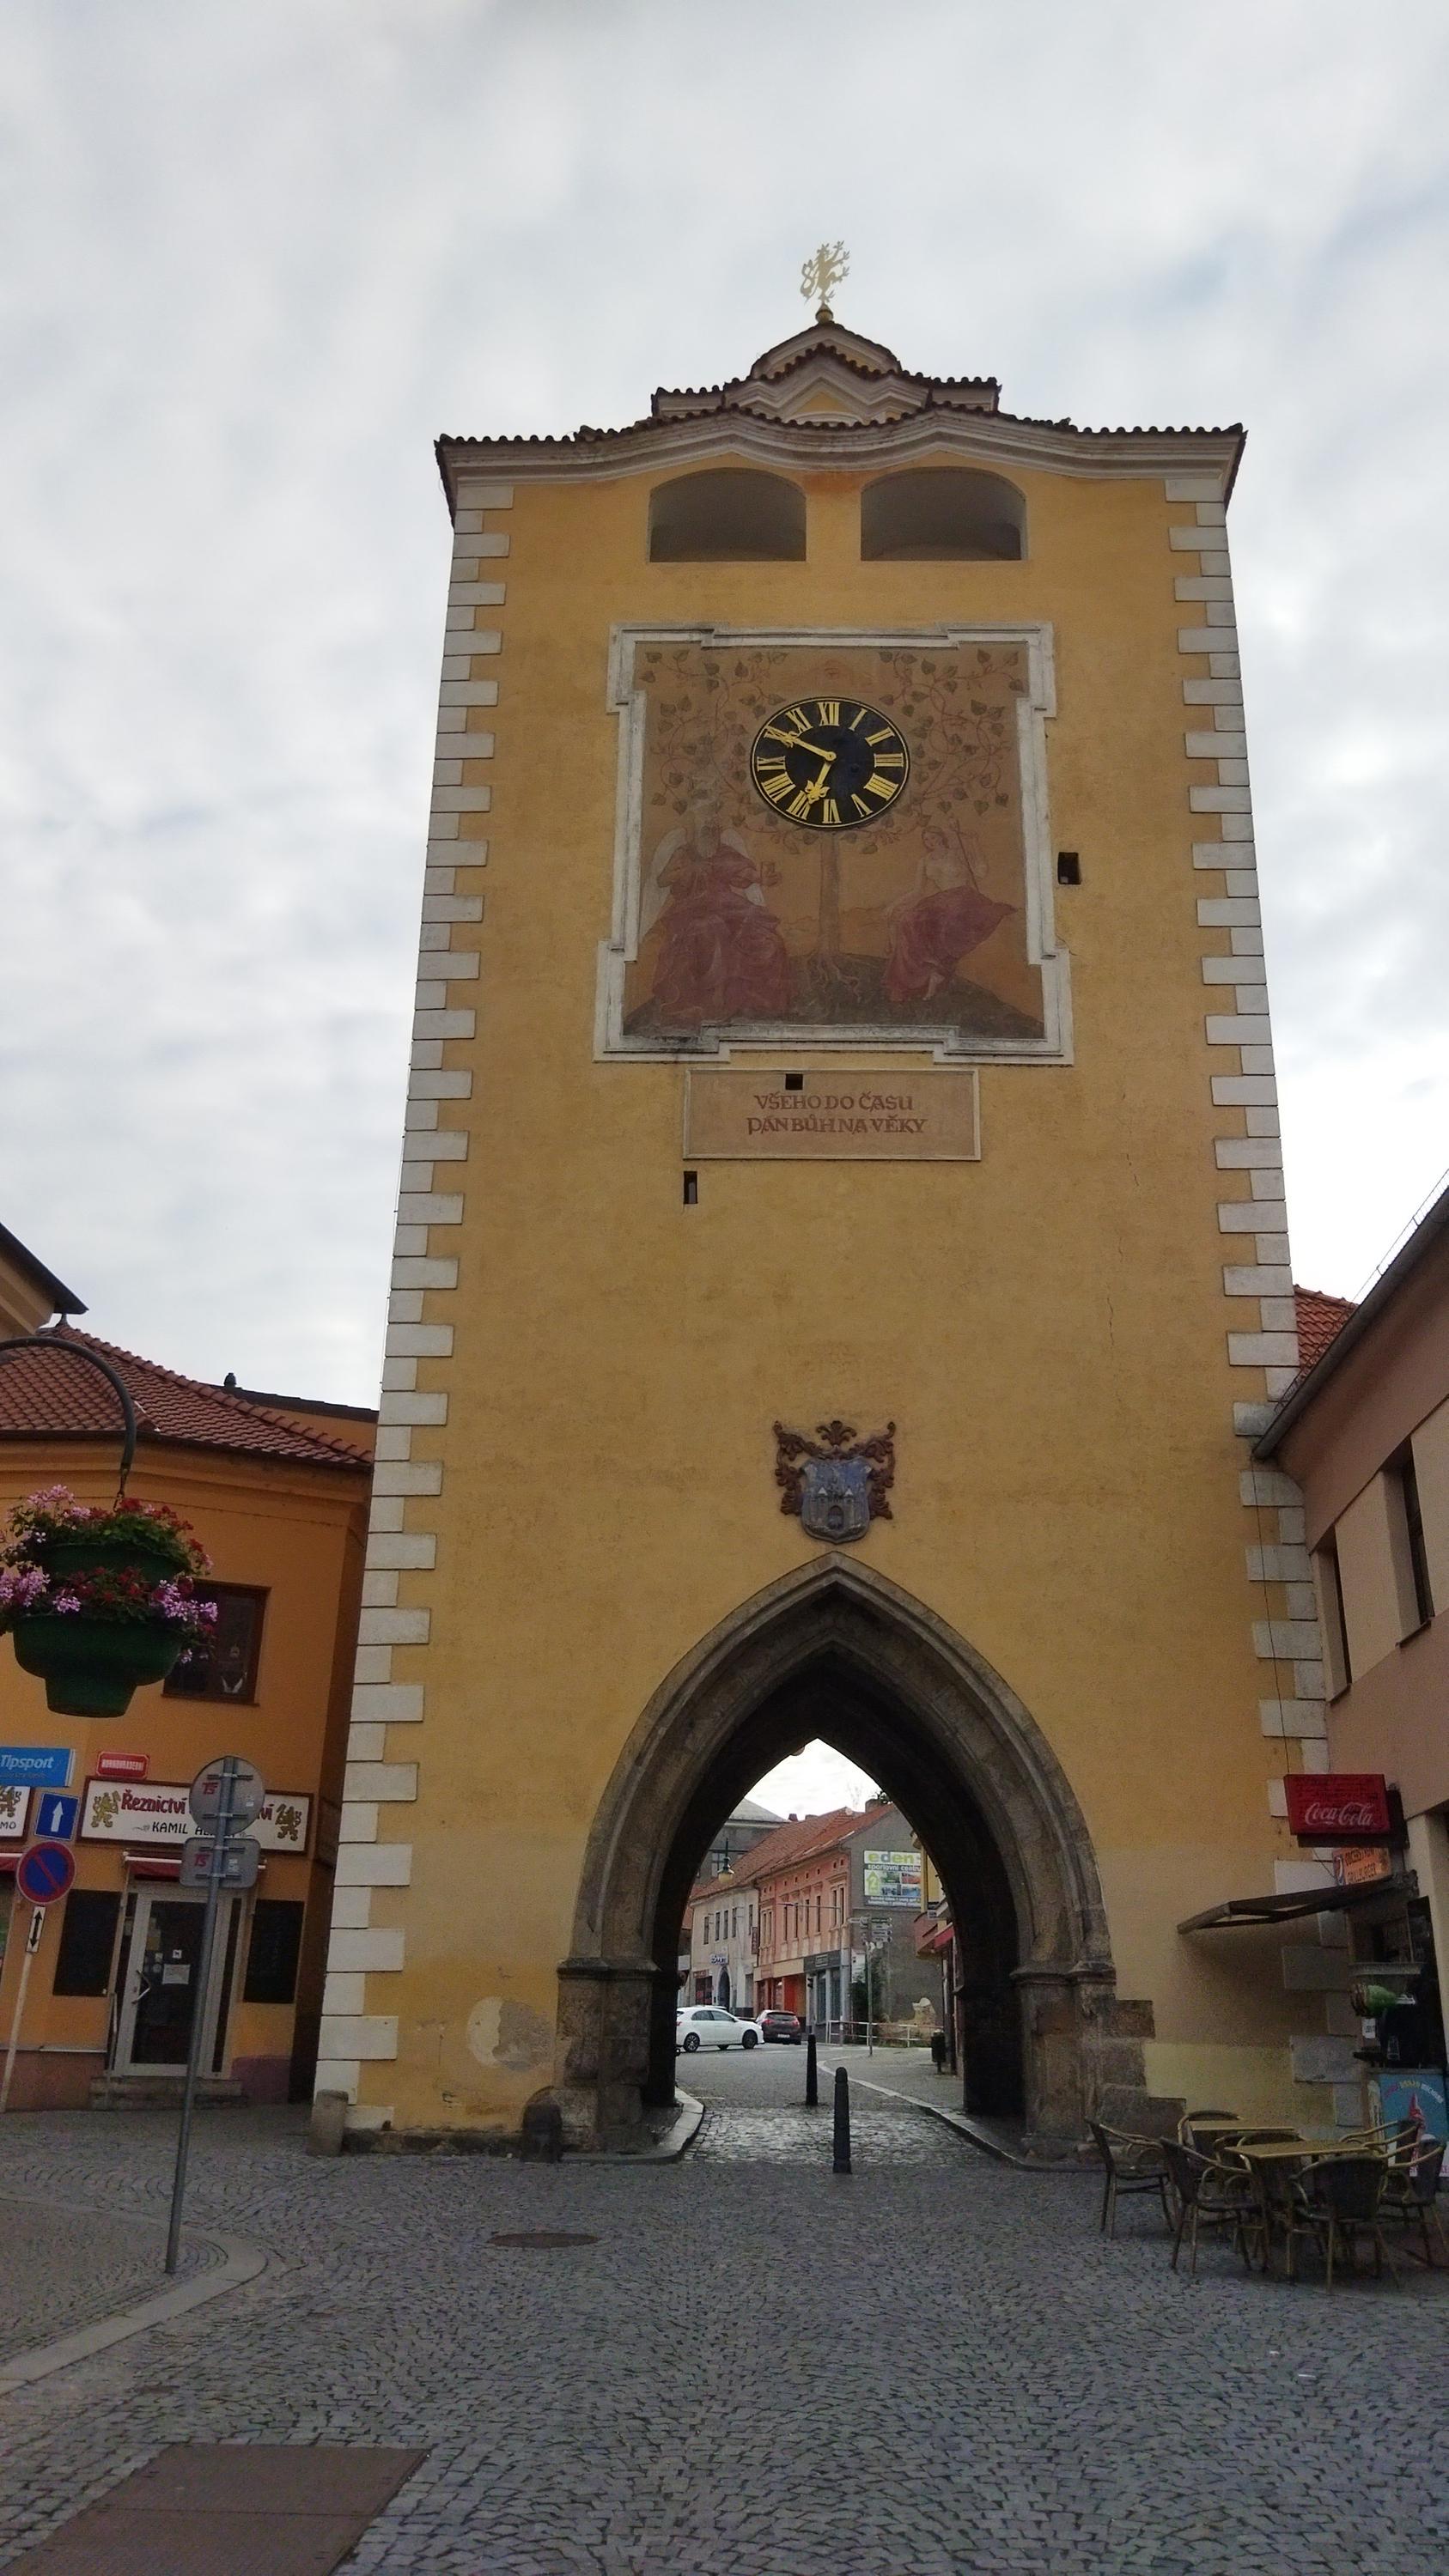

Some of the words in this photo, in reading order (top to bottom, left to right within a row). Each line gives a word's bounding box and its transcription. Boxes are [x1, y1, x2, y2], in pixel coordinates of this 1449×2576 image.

[785, 708, 813, 732] XI
[818, 702, 841, 726] XII
[849, 708, 868, 732] I
[865, 726, 895, 747] II
[757, 755, 787, 772] IX
[874, 753, 904, 768] III
[761, 771, 796, 804] VIII
[822, 799, 842, 823] VI
[850, 793, 874, 818] V
[753, 1091, 822, 1110] VŠEHO
[824, 1096, 855, 1109] DO
[859, 1091, 914, 1112] ČASU
[791, 1114, 837, 1133] BŮH
[838, 1118, 868, 1135] NA
[869, 1115, 928, 1134] VĚKY
[1, 1754, 54, 1771] Tipsport
[121, 1789, 188, 1814] Řeznictví
[1305, 1801, 1375, 1826] Coca-Cola
[152, 1821, 189, 1835] KAMIL
[868, 1850, 914, 1864] eden
